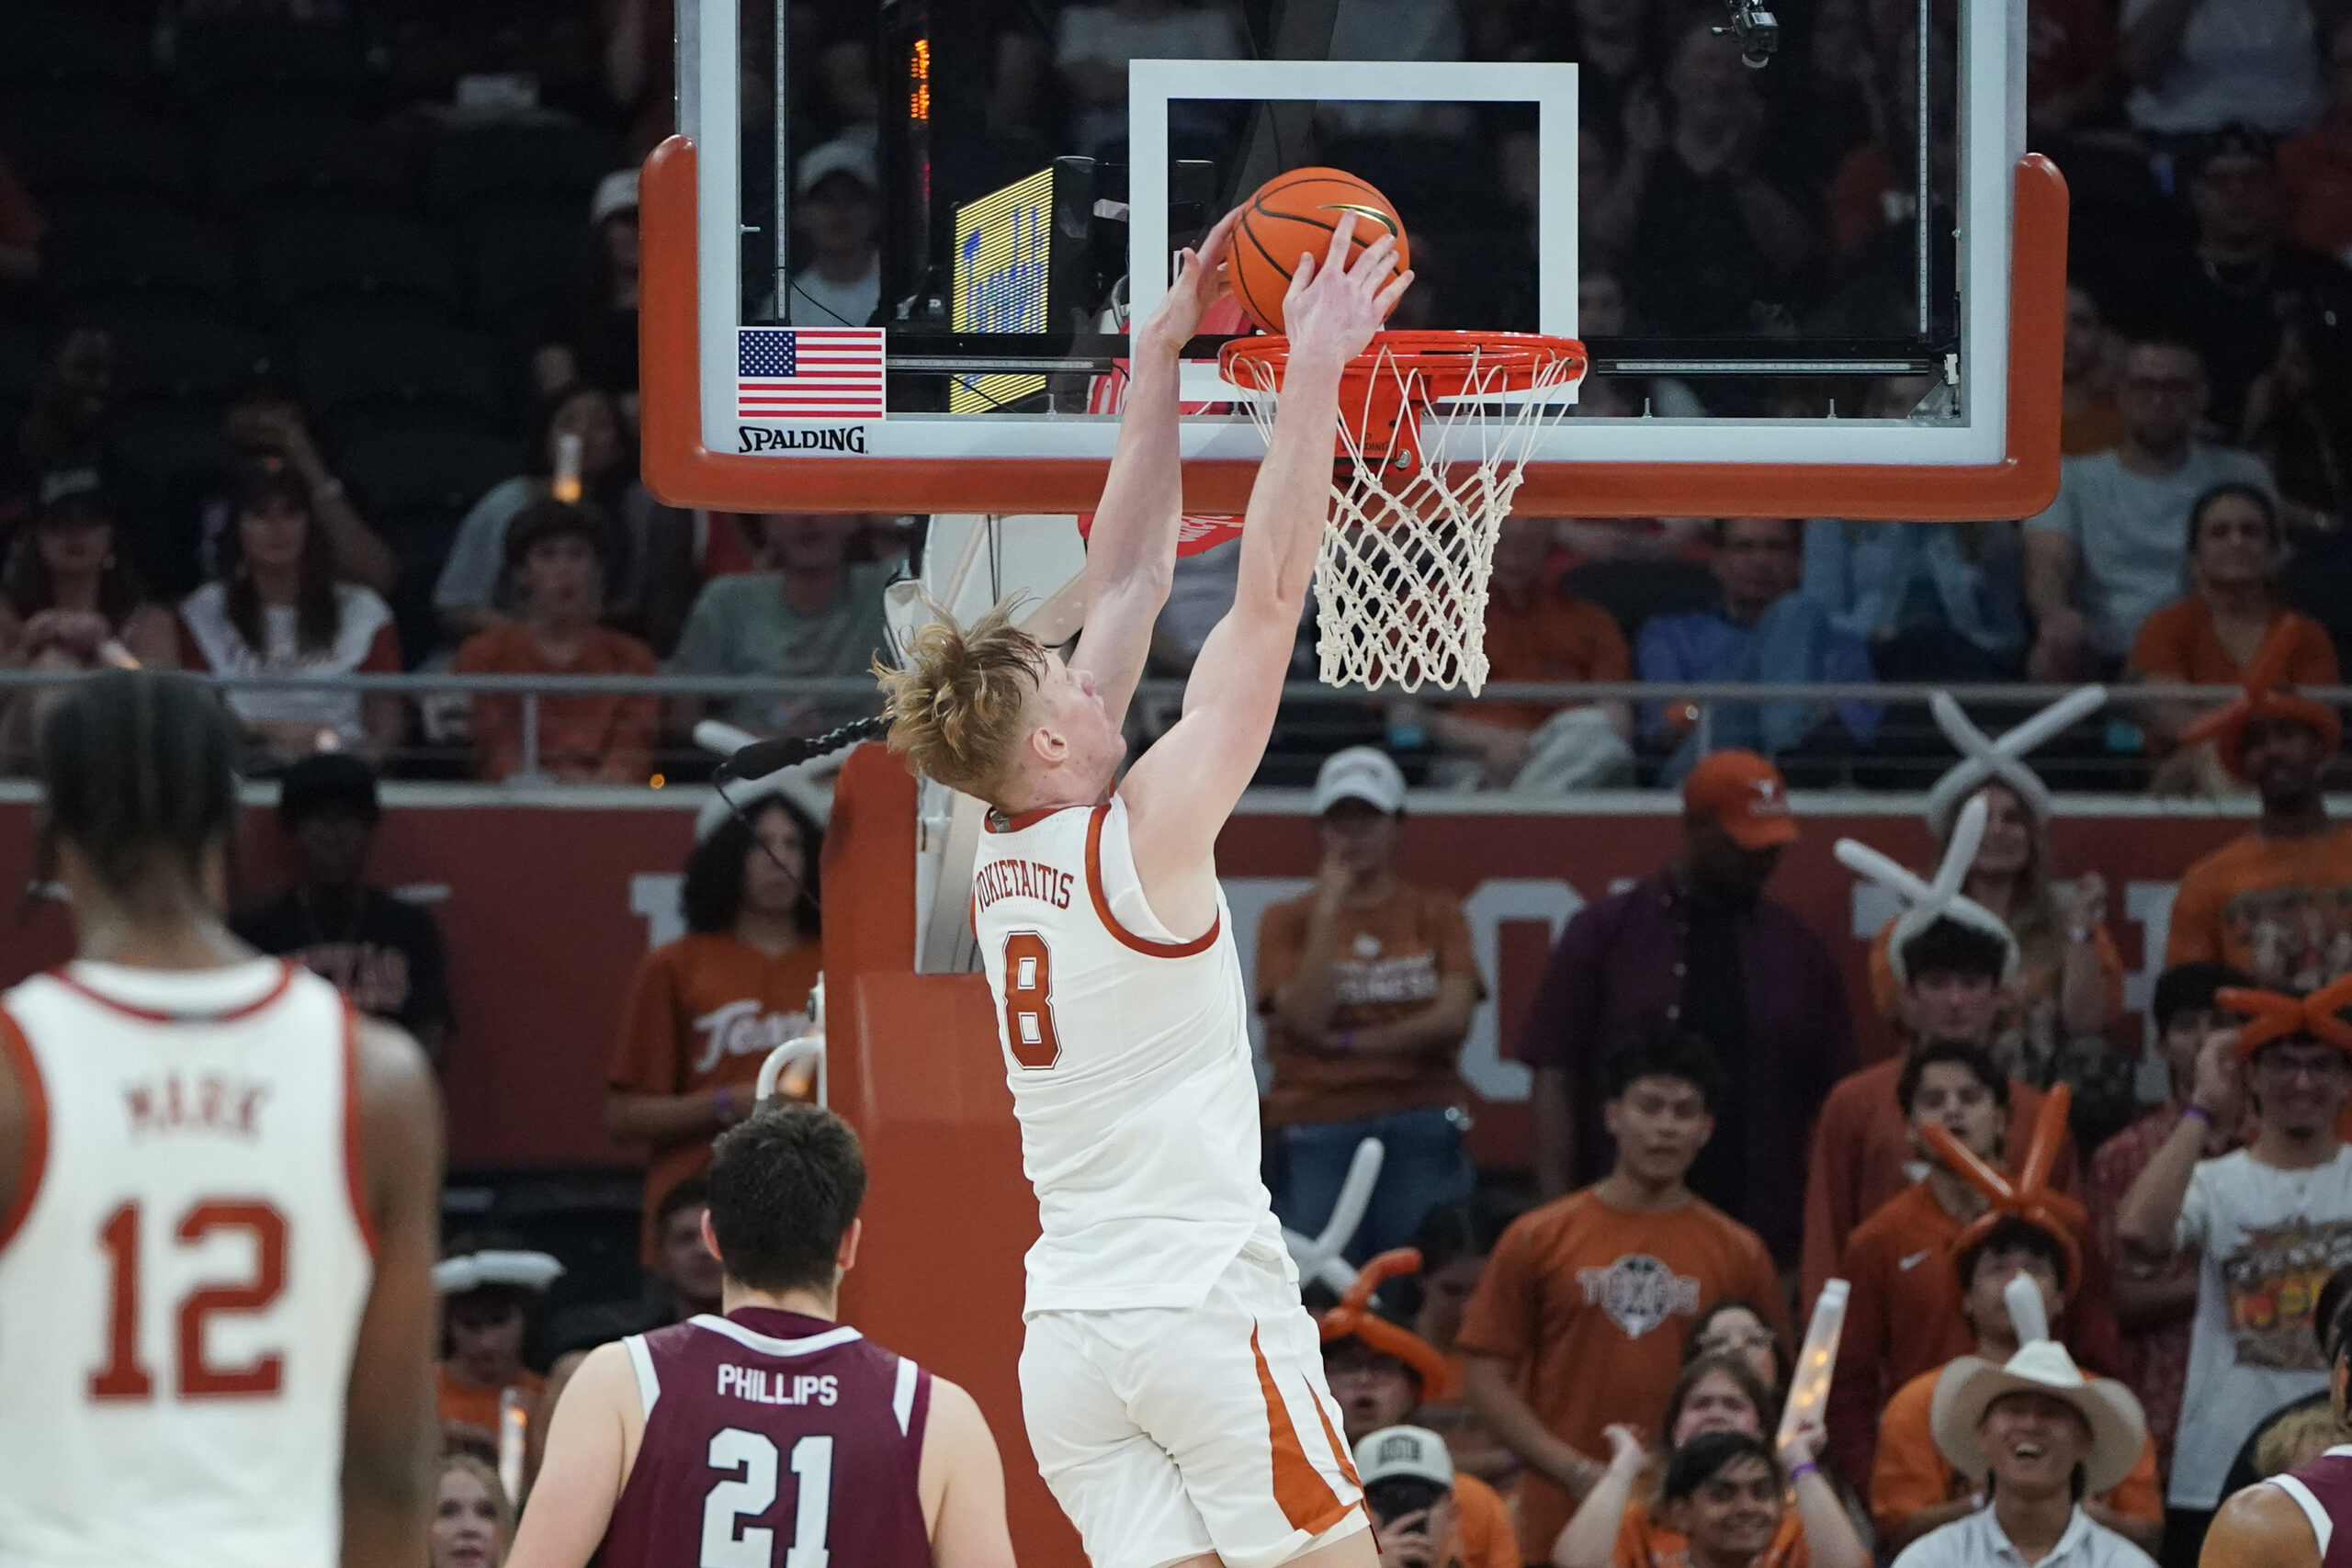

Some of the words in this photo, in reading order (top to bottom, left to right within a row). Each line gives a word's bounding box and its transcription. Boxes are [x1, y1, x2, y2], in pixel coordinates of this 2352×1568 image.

[738, 425, 866, 454] SPALDING
[1002, 931, 1062, 1070] 8
[121, 1067, 273, 1142] MARK
[86, 1198, 291, 1401] 12
[717, 1363, 840, 1407] PHILLIPS
[699, 1427, 834, 1568] 21
